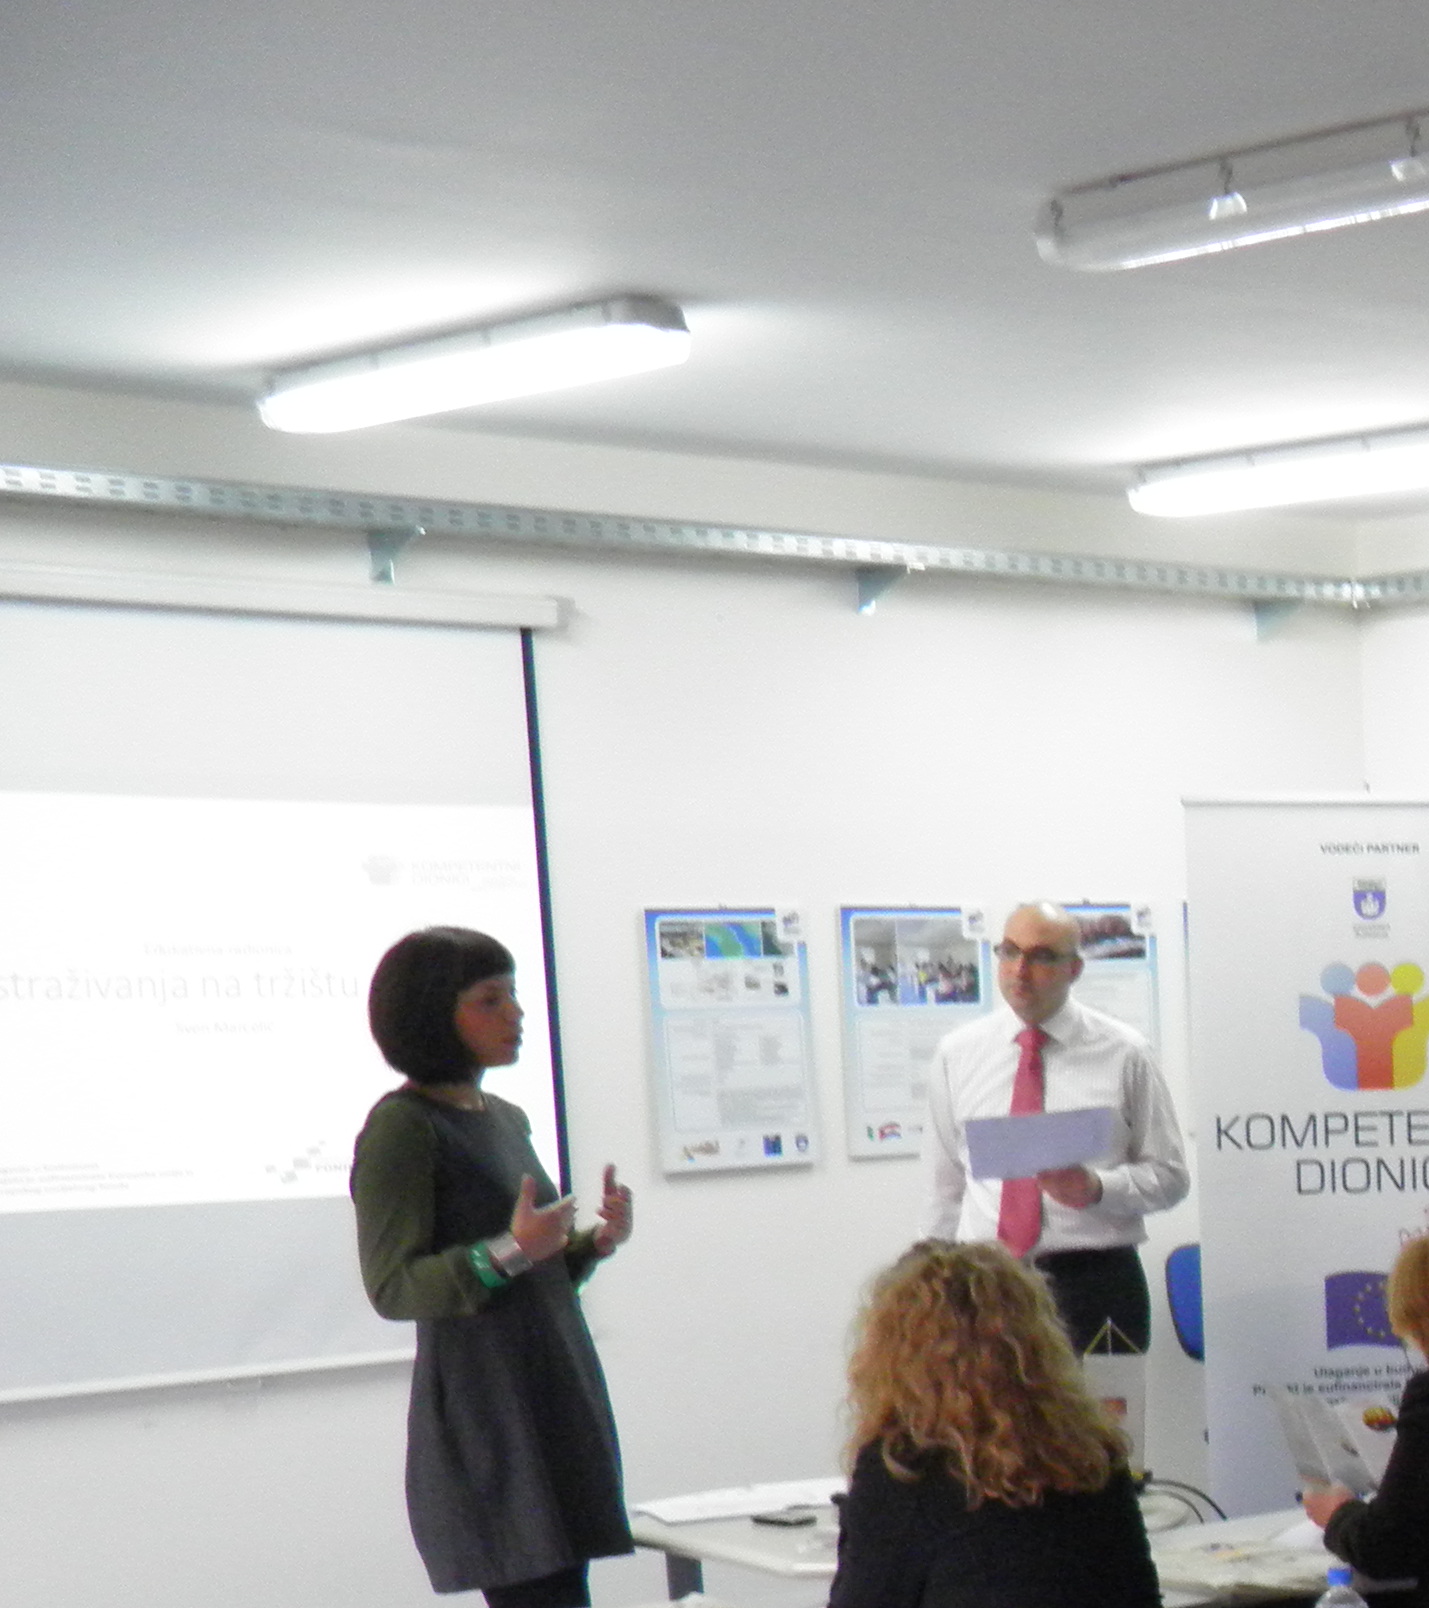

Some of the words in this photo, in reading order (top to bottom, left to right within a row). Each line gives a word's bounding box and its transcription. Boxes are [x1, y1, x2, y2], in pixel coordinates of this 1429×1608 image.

[1366, 842, 1420, 855] PARTNER
[201, 975, 242, 999] na
[254, 967, 360, 1000] tržištu
